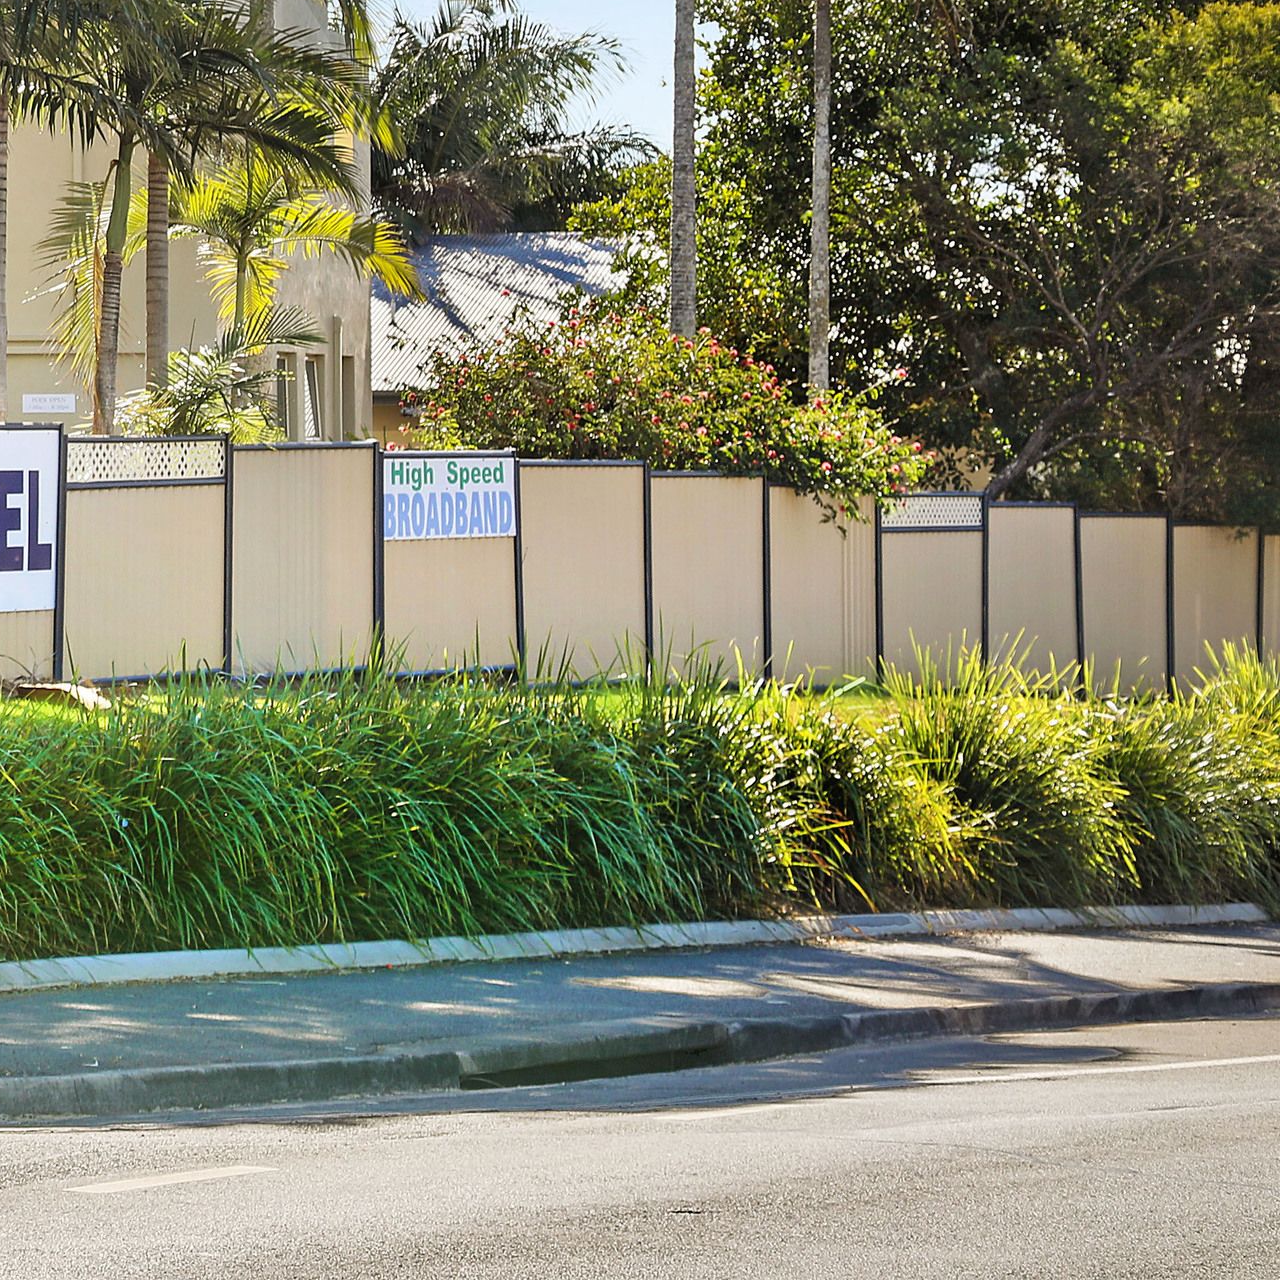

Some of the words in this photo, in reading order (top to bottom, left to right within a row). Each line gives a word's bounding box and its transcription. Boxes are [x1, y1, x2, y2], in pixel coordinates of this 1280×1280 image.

[391, 460, 433, 491] High
[447, 461, 504, 490] Speed
[384, 491, 512, 537] BROADBAND
